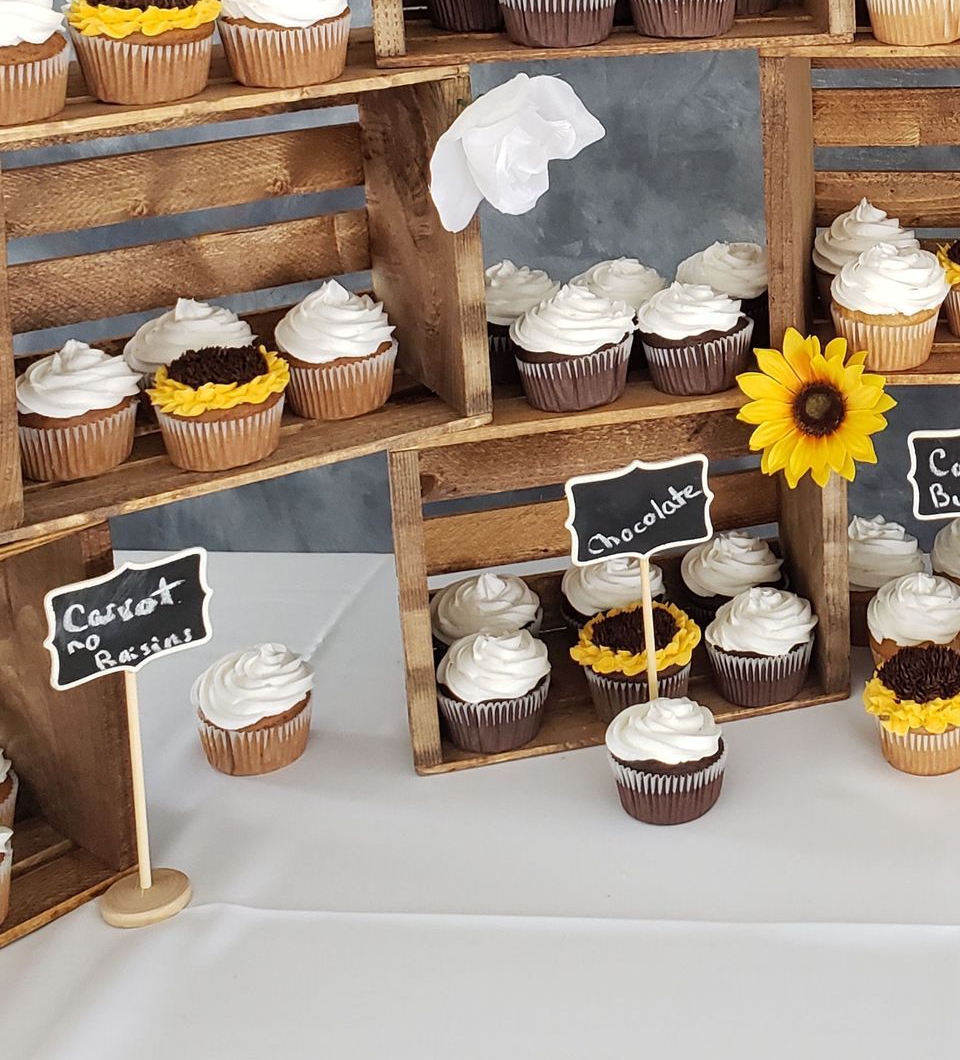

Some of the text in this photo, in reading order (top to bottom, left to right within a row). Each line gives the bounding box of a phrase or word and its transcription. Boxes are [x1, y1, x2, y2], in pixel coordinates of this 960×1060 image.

[63, 577, 186, 632] Carrot
[67, 634, 100, 655] no
[94, 628, 192, 670] Raisins
